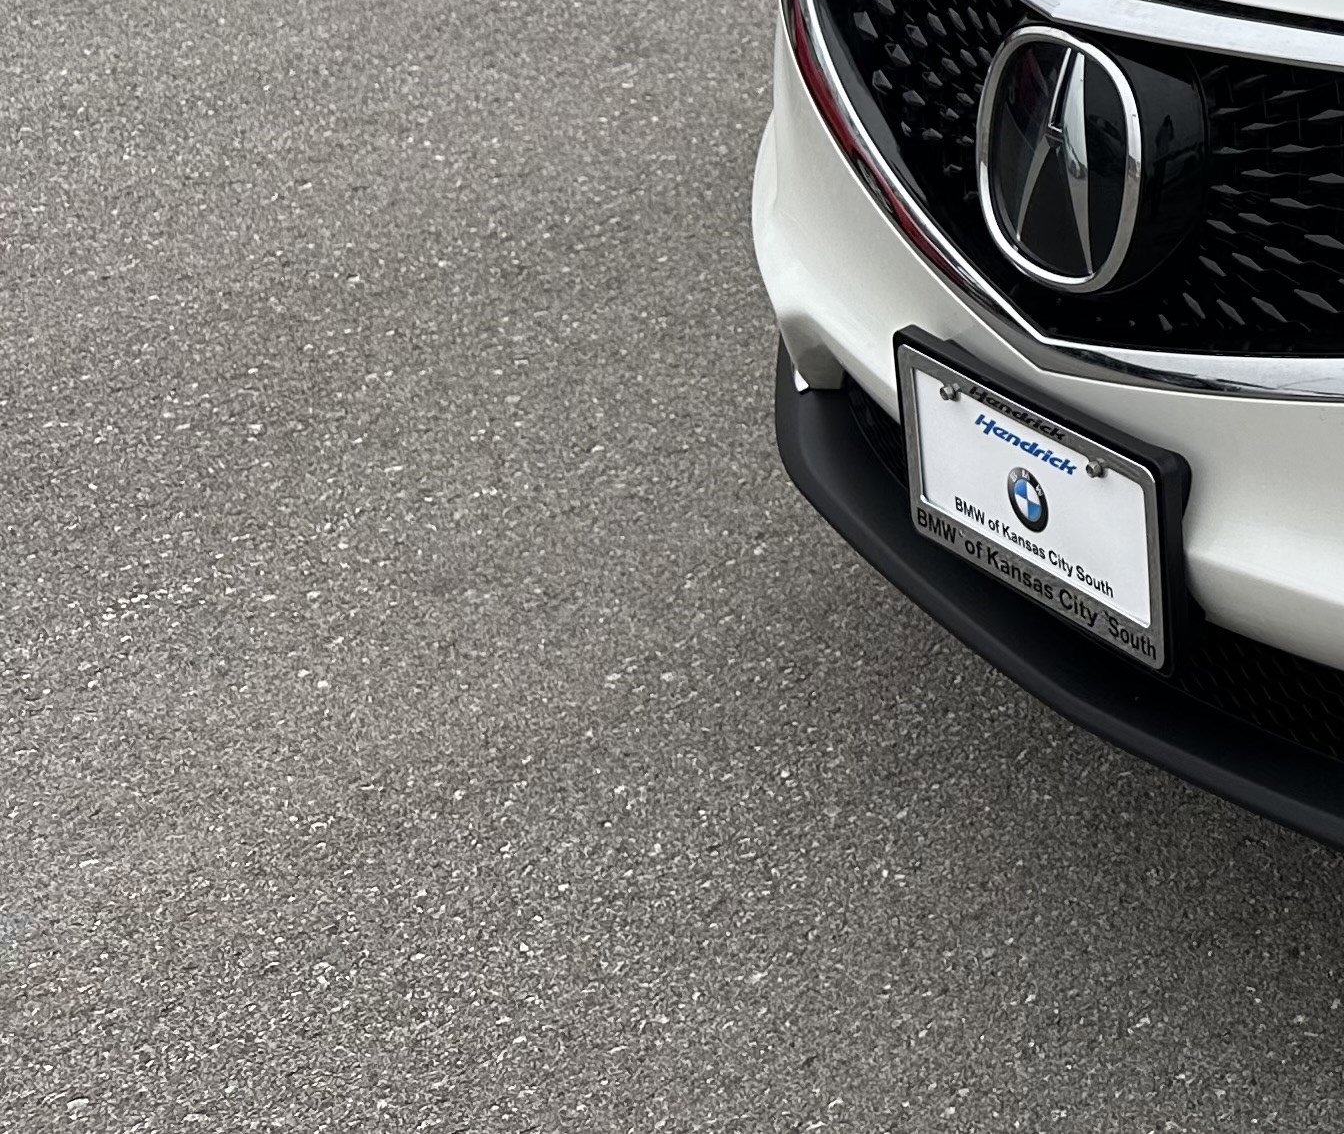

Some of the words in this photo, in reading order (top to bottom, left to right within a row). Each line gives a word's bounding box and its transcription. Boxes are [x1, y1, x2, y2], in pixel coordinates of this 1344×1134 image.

[969, 386, 1066, 441] Hendrick
[974, 414, 1077, 475] Hendrick
[917, 507, 956, 544] BMW
[964, 539, 982, 559] of
[986, 546, 1054, 600] Kansas
[1058, 588, 1099, 628] City
[1107, 616, 1157, 660] South
[955, 496, 985, 525] BMW
[988, 517, 1001, 532] of
[1002, 525, 1046, 560] Kansas
[1048, 550, 1074, 577] City
[1076, 565, 1114, 598] South
